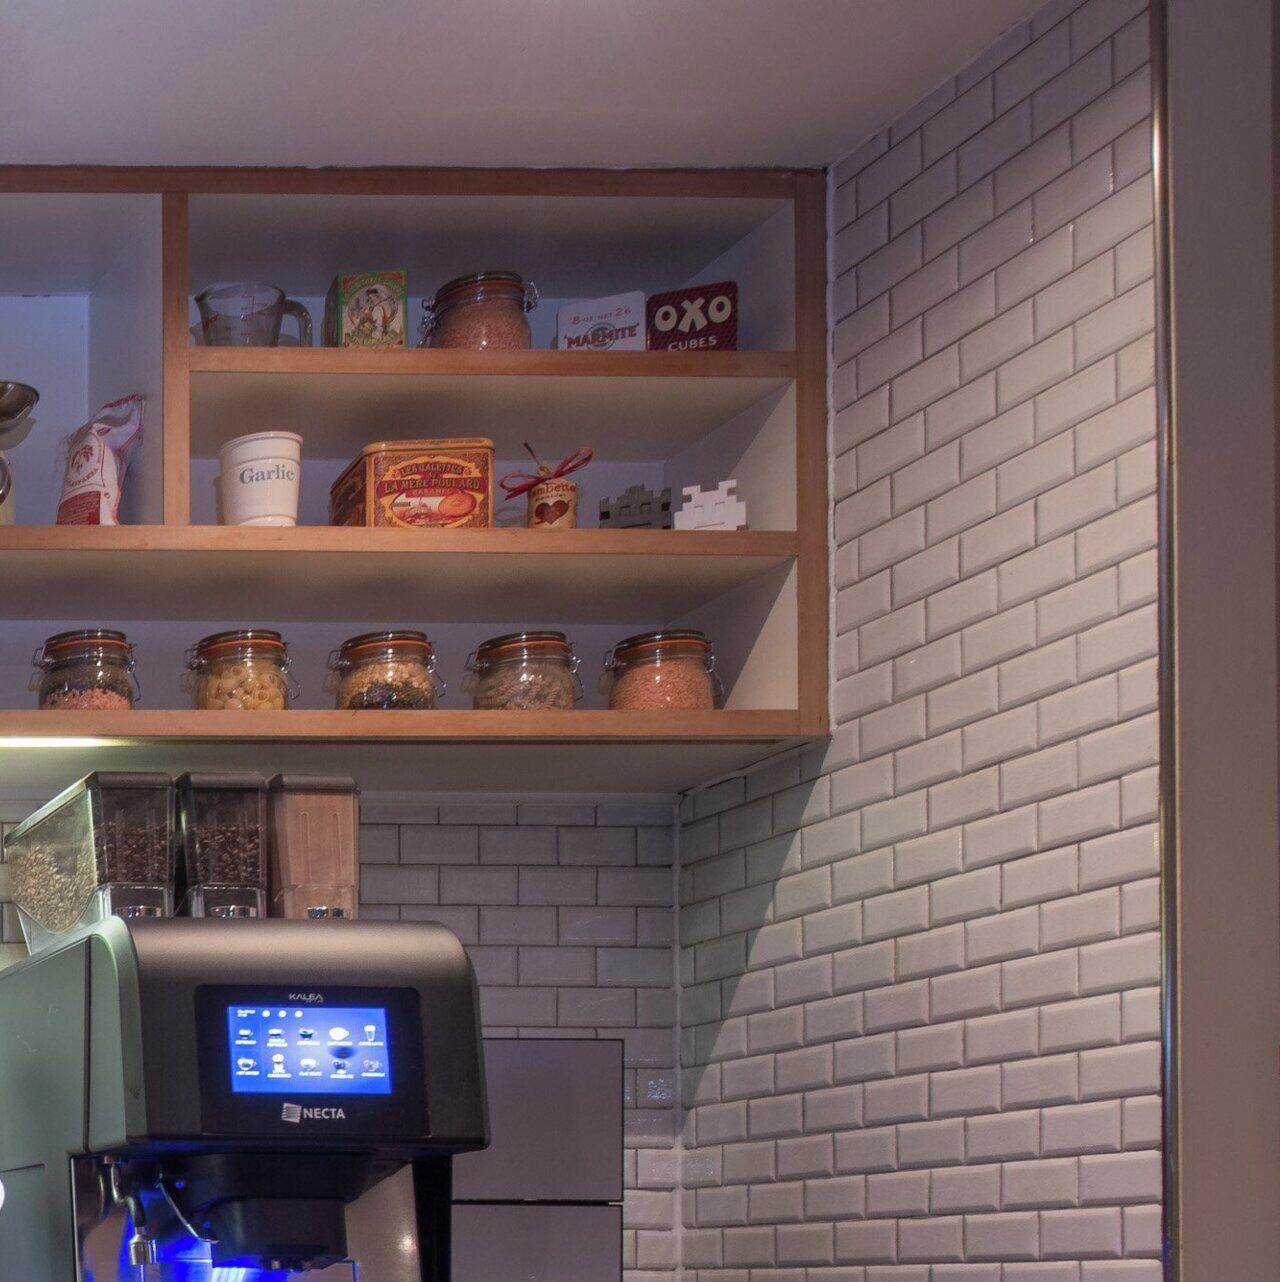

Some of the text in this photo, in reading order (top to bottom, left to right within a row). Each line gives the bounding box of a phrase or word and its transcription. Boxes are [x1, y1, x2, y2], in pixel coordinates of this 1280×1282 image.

[655, 295, 732, 333] OXO
[668, 335, 718, 351] CUBES
[240, 464, 295, 484] Garlic
[385, 482, 399, 492] LA
[432, 479, 481, 490] POULARD
[303, 1107, 346, 1119] NECTA
